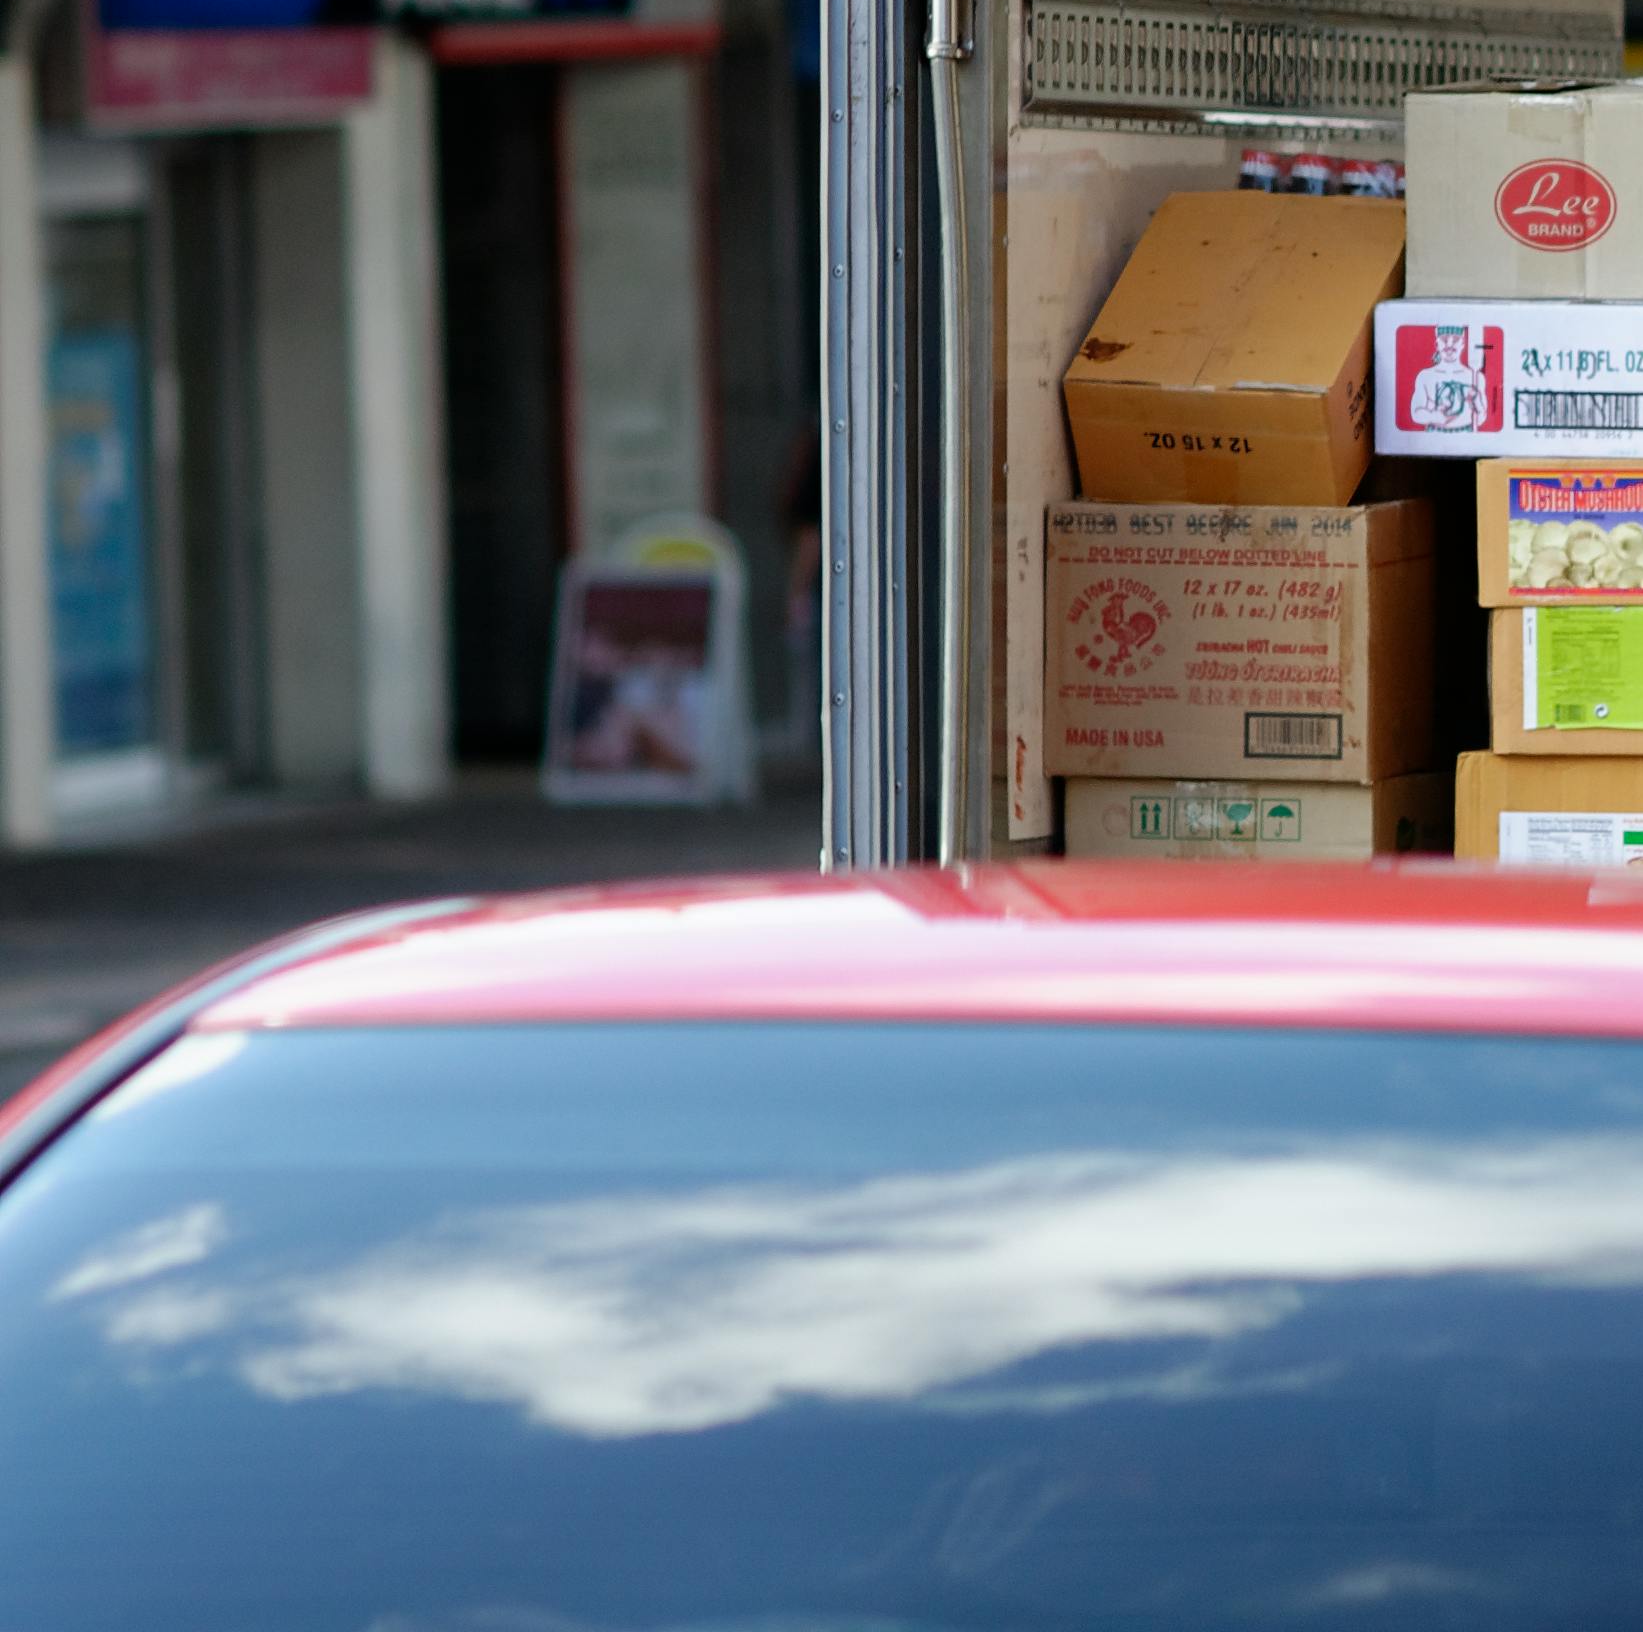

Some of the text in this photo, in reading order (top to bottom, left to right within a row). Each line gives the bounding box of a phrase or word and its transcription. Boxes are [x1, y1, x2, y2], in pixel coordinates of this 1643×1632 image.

[1512, 172, 1599, 216] Lee
[1528, 224, 1584, 236] BRAND
[1183, 434, 1204, 450] 15
[1230, 437, 1252, 454] 12
[1089, 547, 1110, 558] DO
[1114, 547, 1142, 558] NOT
[1145, 548, 1173, 558] CUT
[1179, 548, 1230, 560] BELOW
[1183, 580, 1202, 595] 12
[1223, 580, 1242, 595] 17
[1278, 580, 1320, 602] (482
[1065, 728, 1164, 747] MADE IN USA
